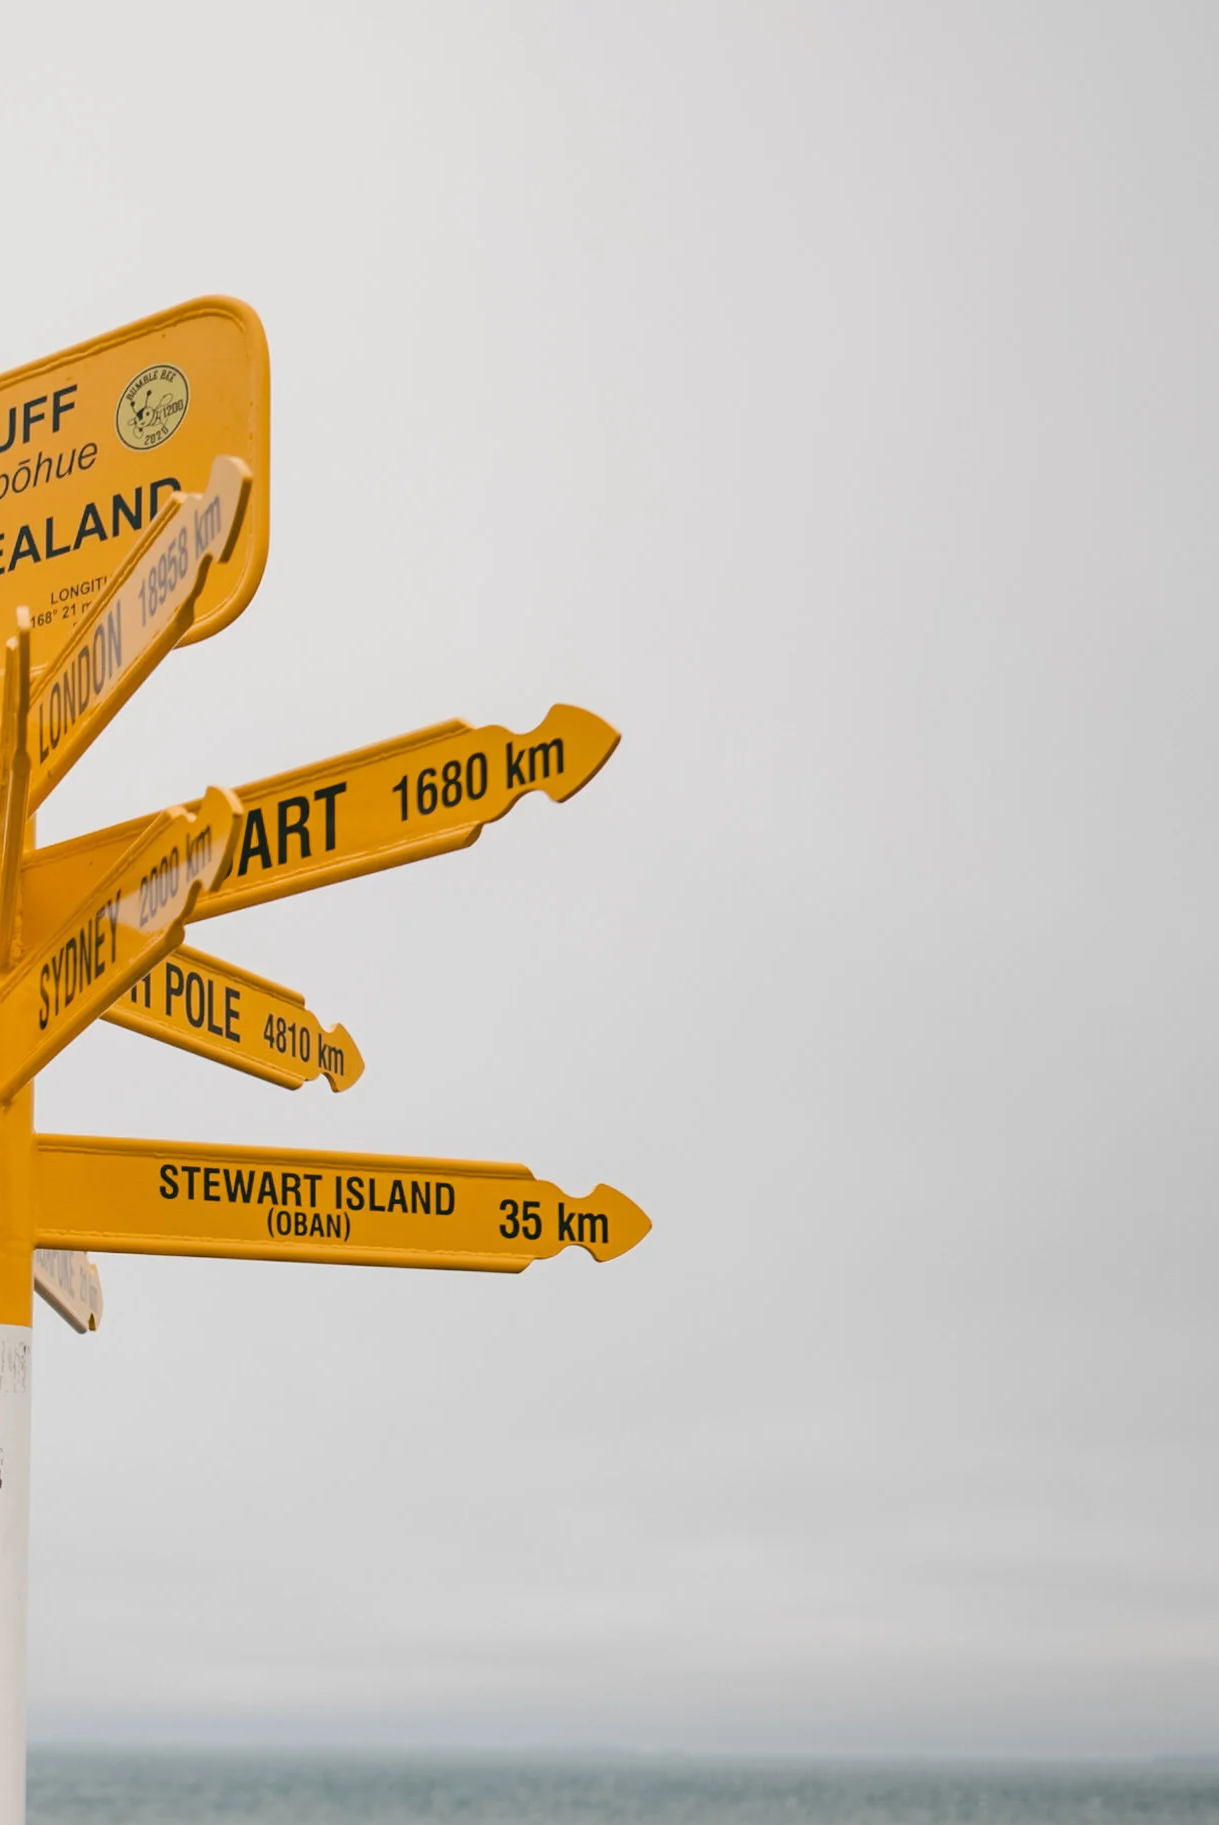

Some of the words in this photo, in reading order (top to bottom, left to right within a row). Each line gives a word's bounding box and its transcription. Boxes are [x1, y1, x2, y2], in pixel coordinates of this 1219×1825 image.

[160, 369, 177, 383] BEE
[50, 576, 108, 605] LONGIT
[62, 603, 76, 619] 21
[38, 599, 123, 765] LONDON
[138, 526, 189, 627] 18958
[194, 495, 222, 557] km
[225, 781, 348, 880] ART
[392, 751, 488, 822] 1680
[505, 736, 565, 790] km
[39, 888, 122, 1031] SYDNEY
[139, 845, 180, 929] 2000
[185, 823, 213, 885] km
[166, 961, 241, 1045] POLE
[263, 1013, 310, 1064] 4810
[318, 1033, 345, 1076] km
[159, 1164, 322, 1209] STEWART
[335, 1175, 456, 1216] ISLAND
[267, 1207, 352, 1243] (OBAN)
[498, 1199, 543, 1241] 35
[558, 1203, 609, 1244] km
